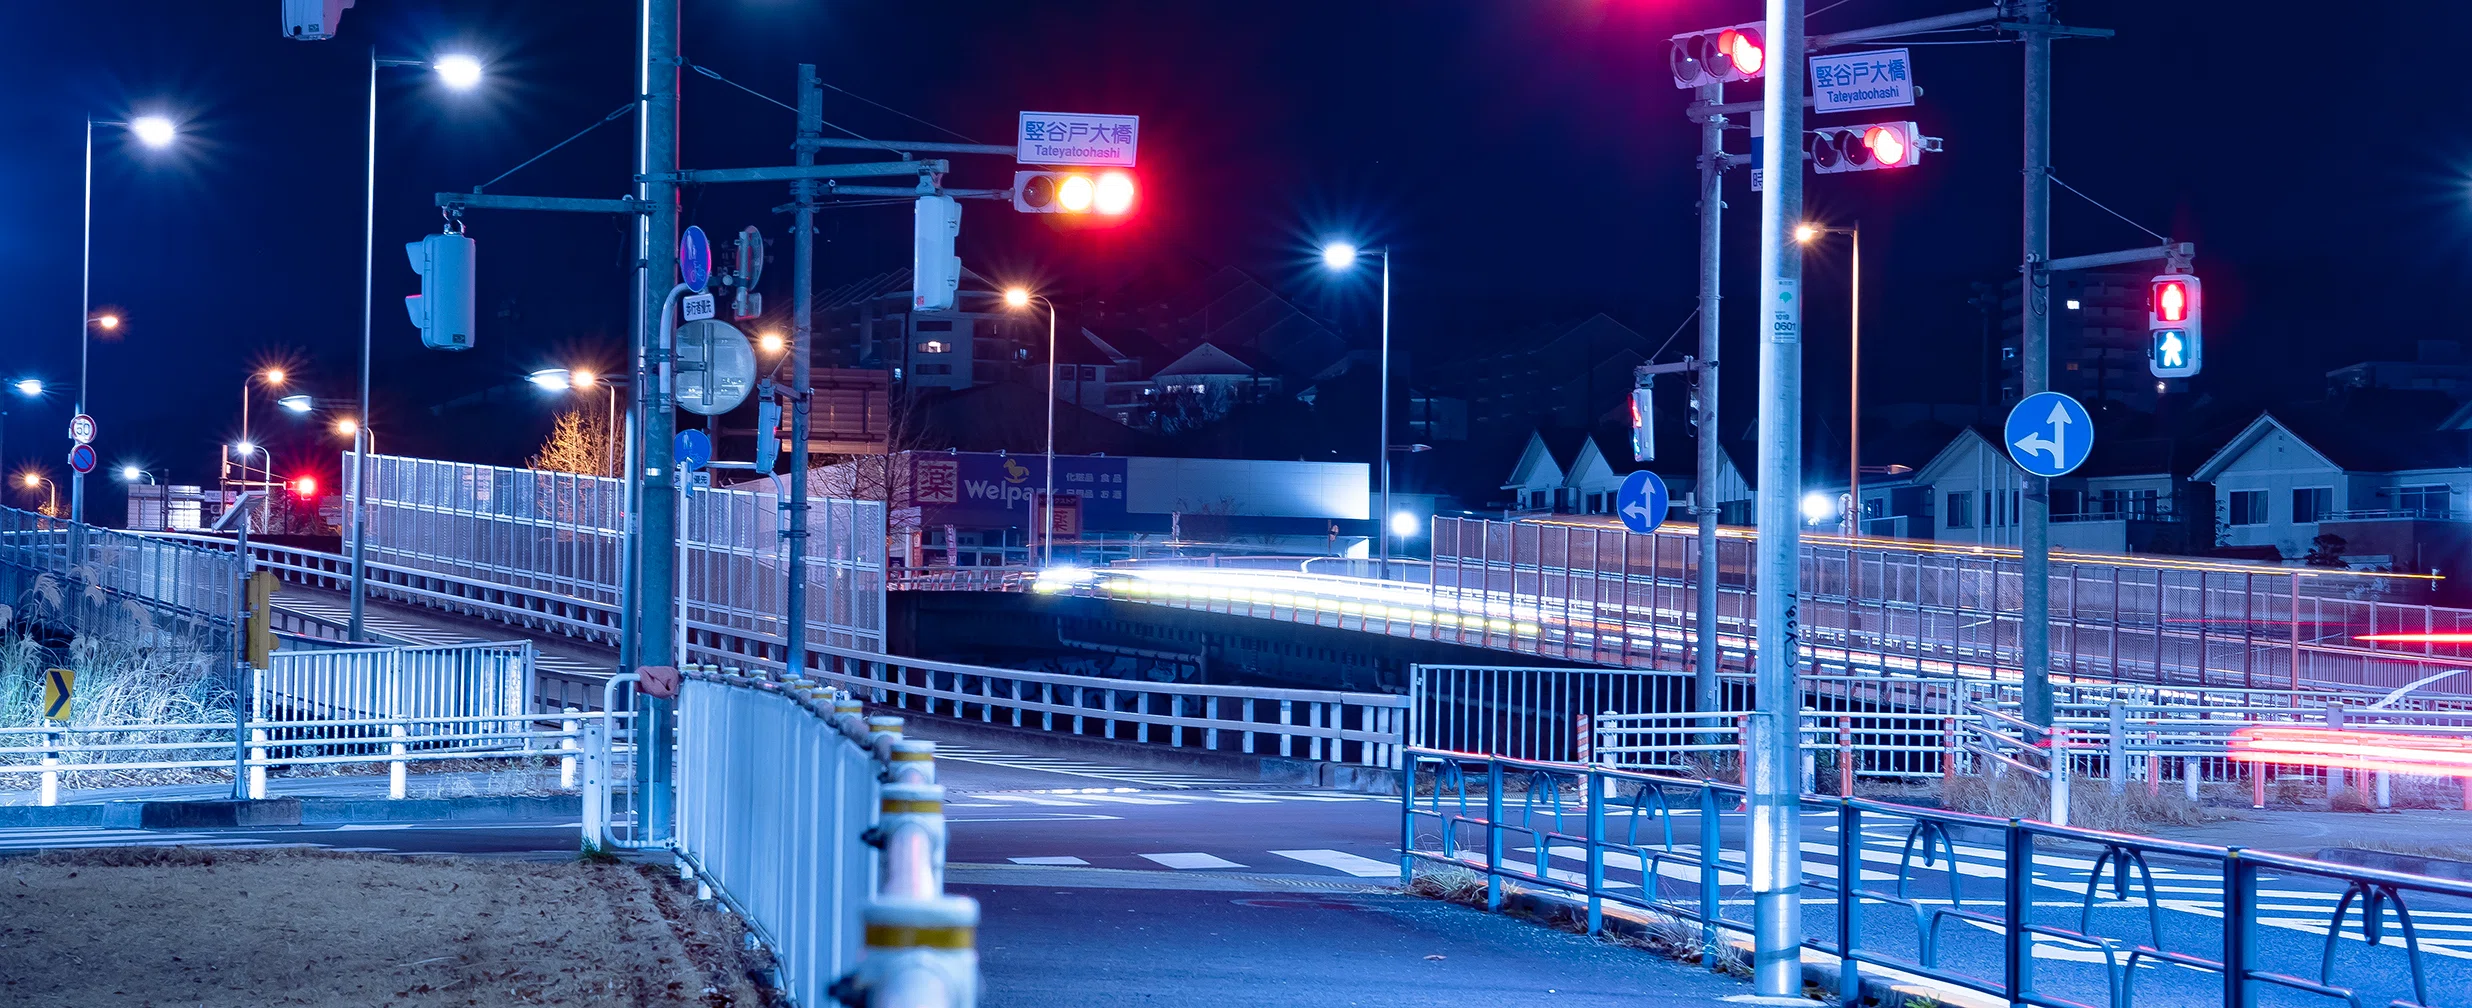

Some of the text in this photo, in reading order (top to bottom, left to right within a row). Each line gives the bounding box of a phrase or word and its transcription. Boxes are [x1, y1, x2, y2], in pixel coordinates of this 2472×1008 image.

[1827, 86, 1899, 104] Tateyatoohashi
[1034, 144, 1121, 159] Tateyatoohashi
[1773, 321, 1797, 331] 0601
[76, 422, 91, 436] 50
[918, 463, 955, 499] 薬
